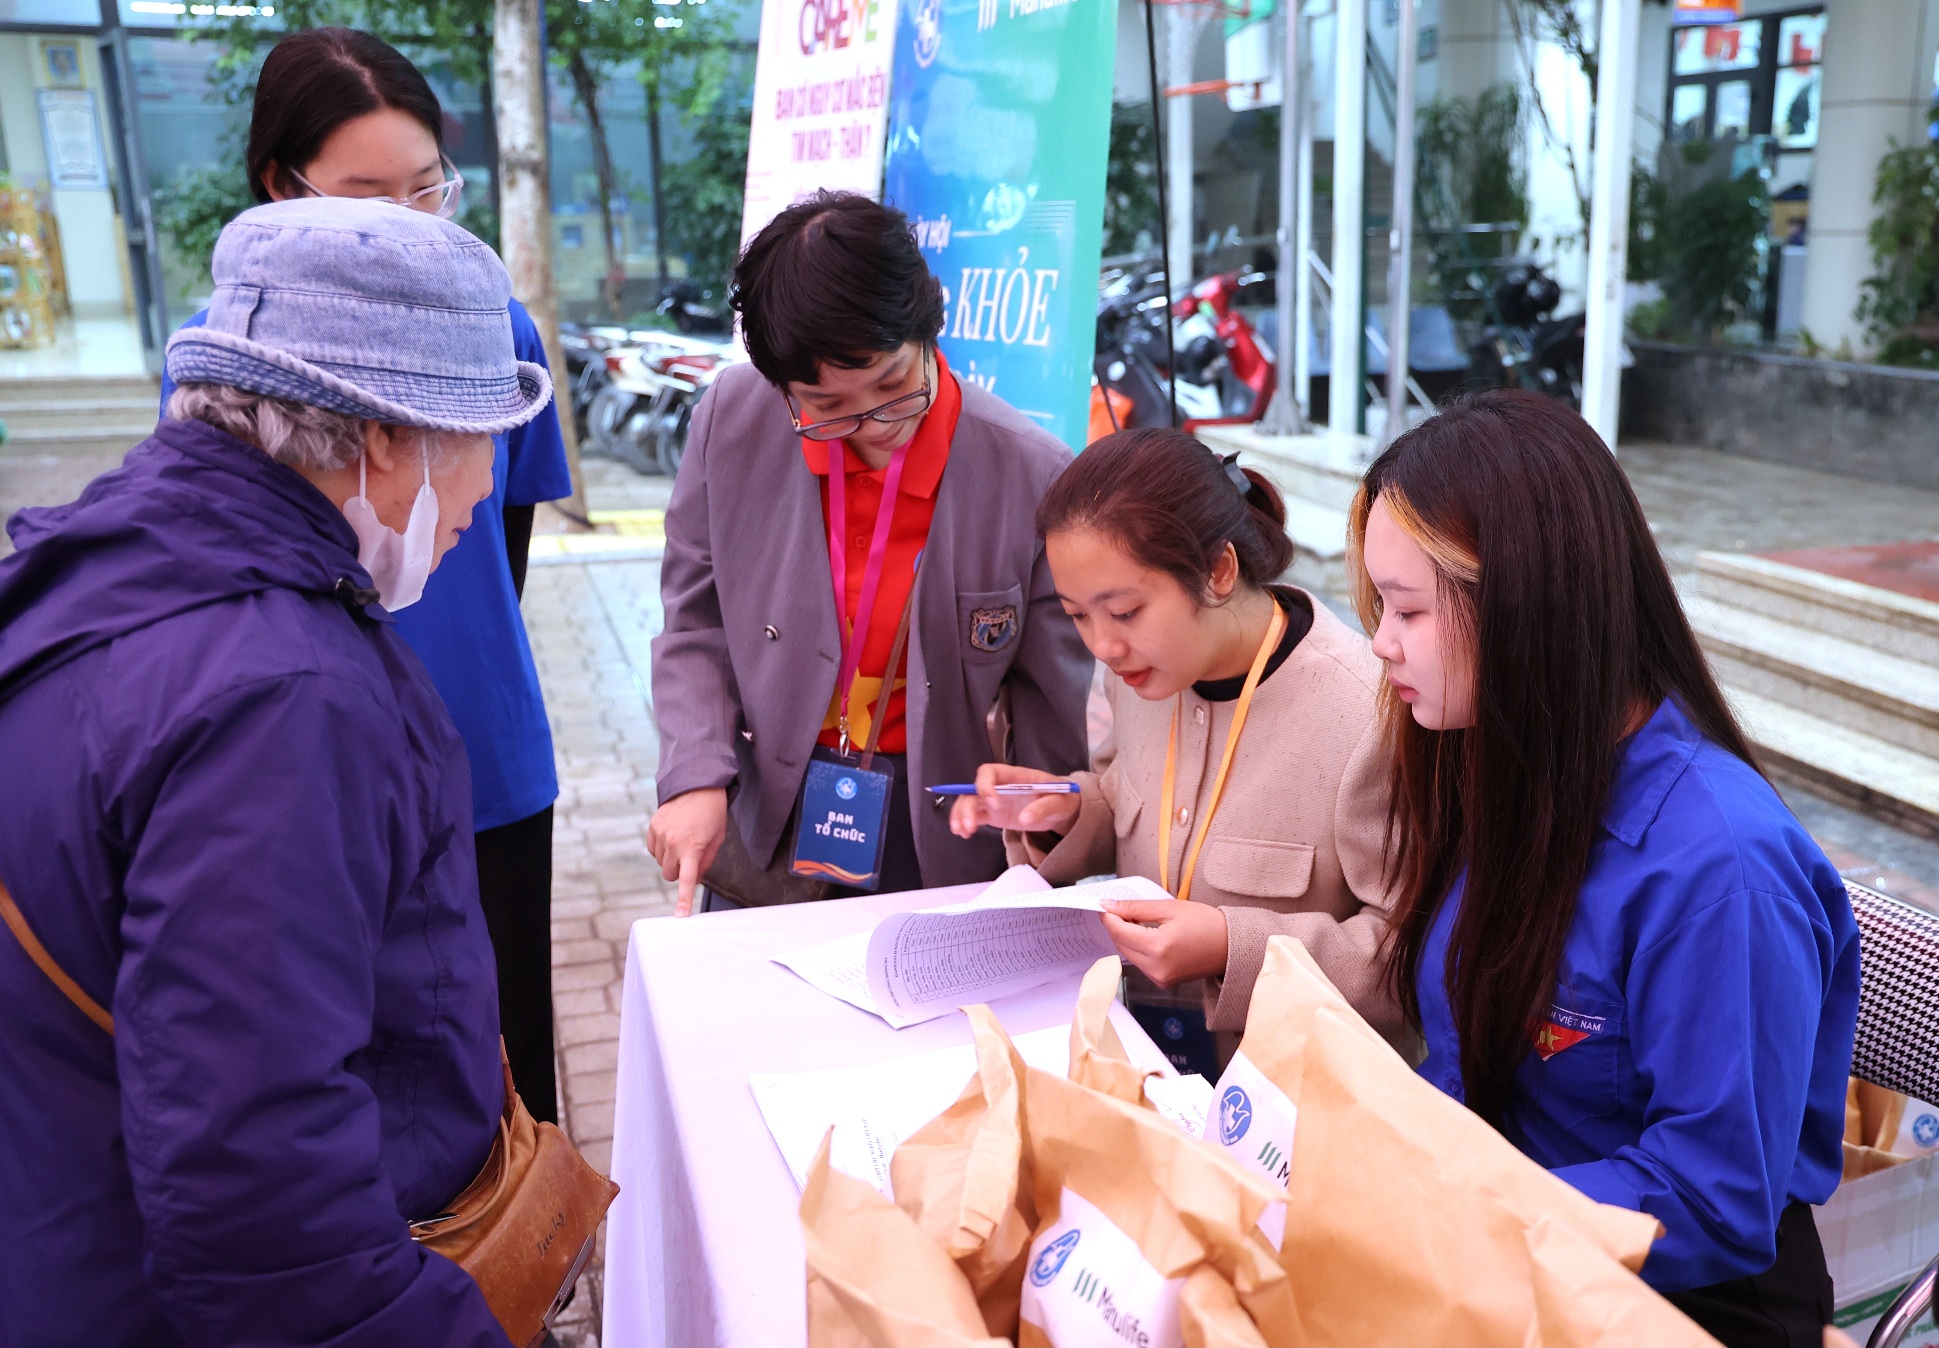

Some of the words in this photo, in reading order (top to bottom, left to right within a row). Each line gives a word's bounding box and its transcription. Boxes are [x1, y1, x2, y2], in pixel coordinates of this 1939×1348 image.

[927, 213, 952, 255] HỘI
[951, 245, 1060, 347] KHỎE
[827, 811, 854, 825] BAN
[814, 820, 832, 836] TỔ
[1558, 1013, 1578, 1027] VIỆT
[1580, 1020, 1601, 1032] NAM
